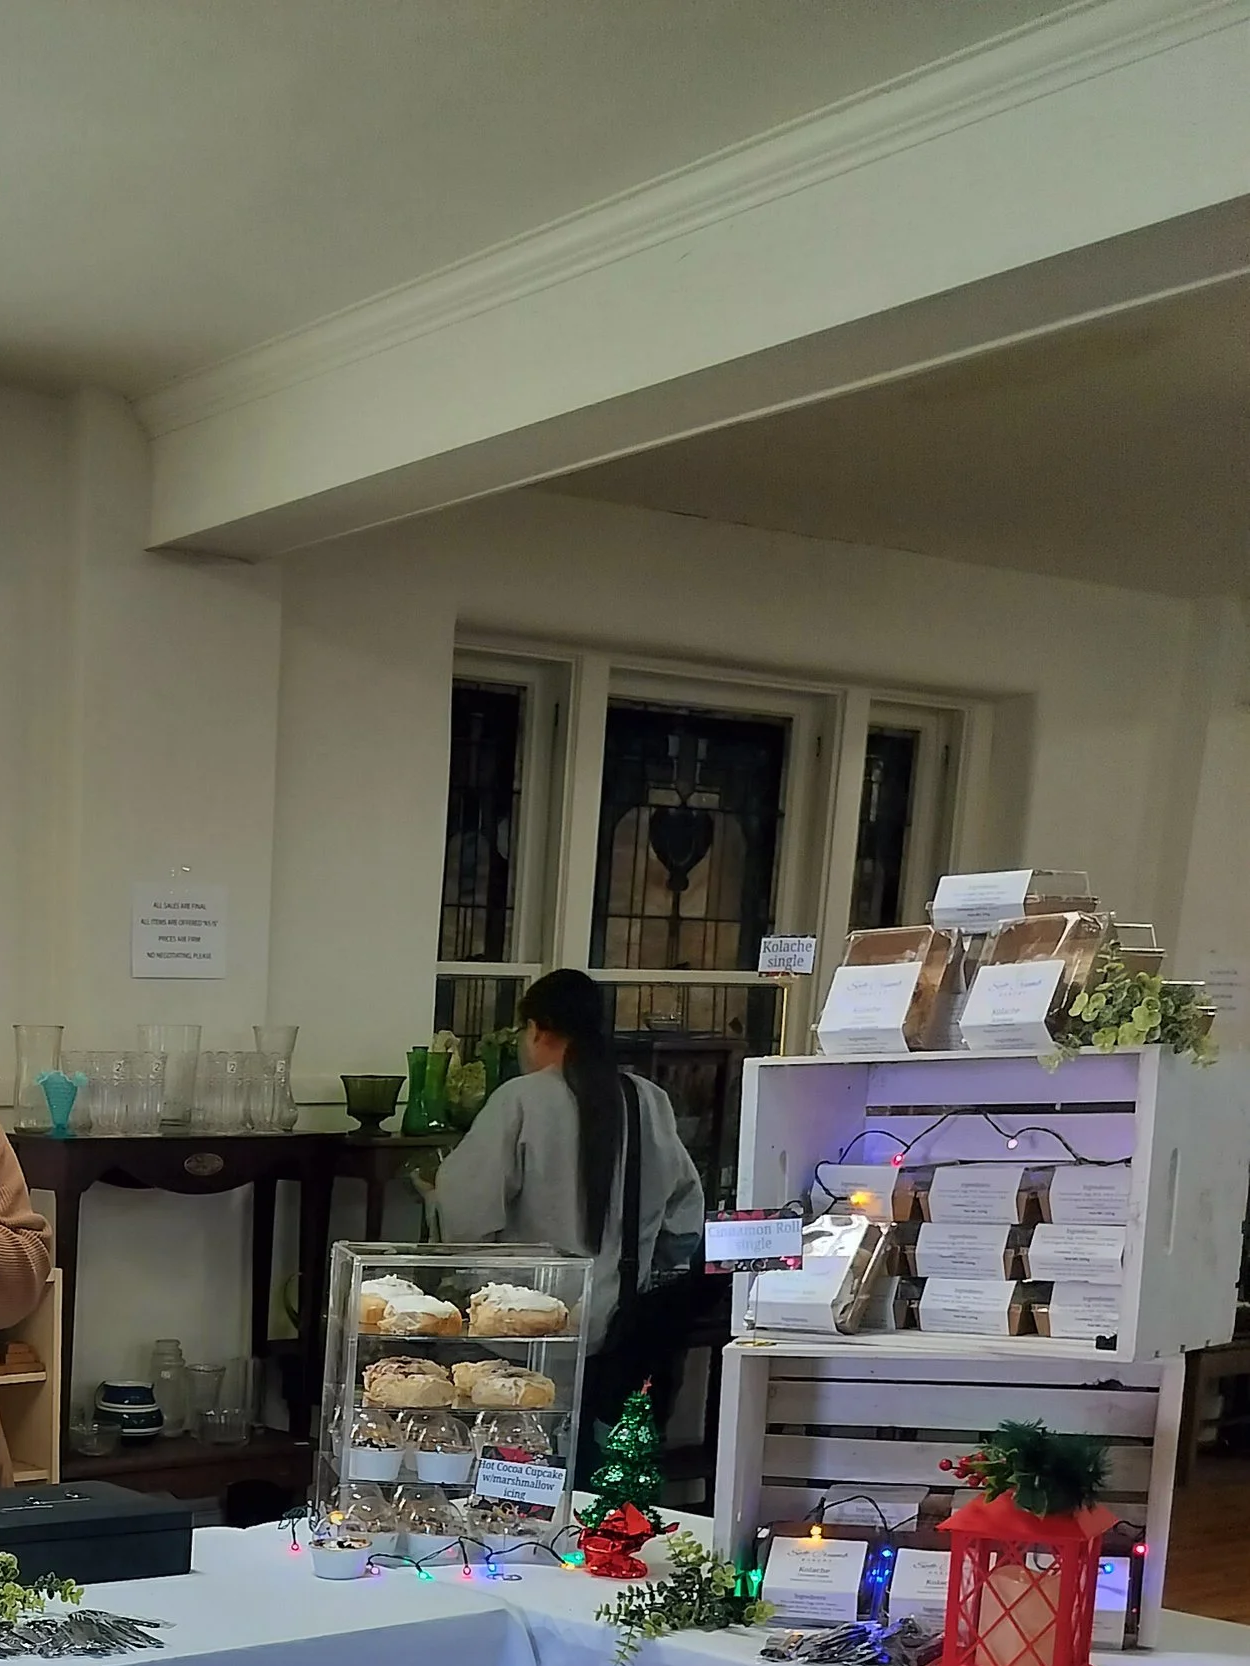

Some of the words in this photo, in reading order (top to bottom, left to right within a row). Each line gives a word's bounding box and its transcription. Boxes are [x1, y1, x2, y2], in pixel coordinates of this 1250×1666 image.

[762, 939, 813, 953] Kolache
[767, 954, 804, 970] single
[708, 1223, 772, 1238] Cinnamon
[776, 1220, 801, 1234] Roll
[735, 1237, 772, 1252] single
[479, 1460, 495, 1470] Hot
[496, 1462, 523, 1474] Cocoa
[525, 1466, 564, 1480] Cupcake
[482, 1473, 556, 1491] w/marshmallow
[503, 1487, 527, 1500] icing
[798, 1566, 831, 1574] Kolache
